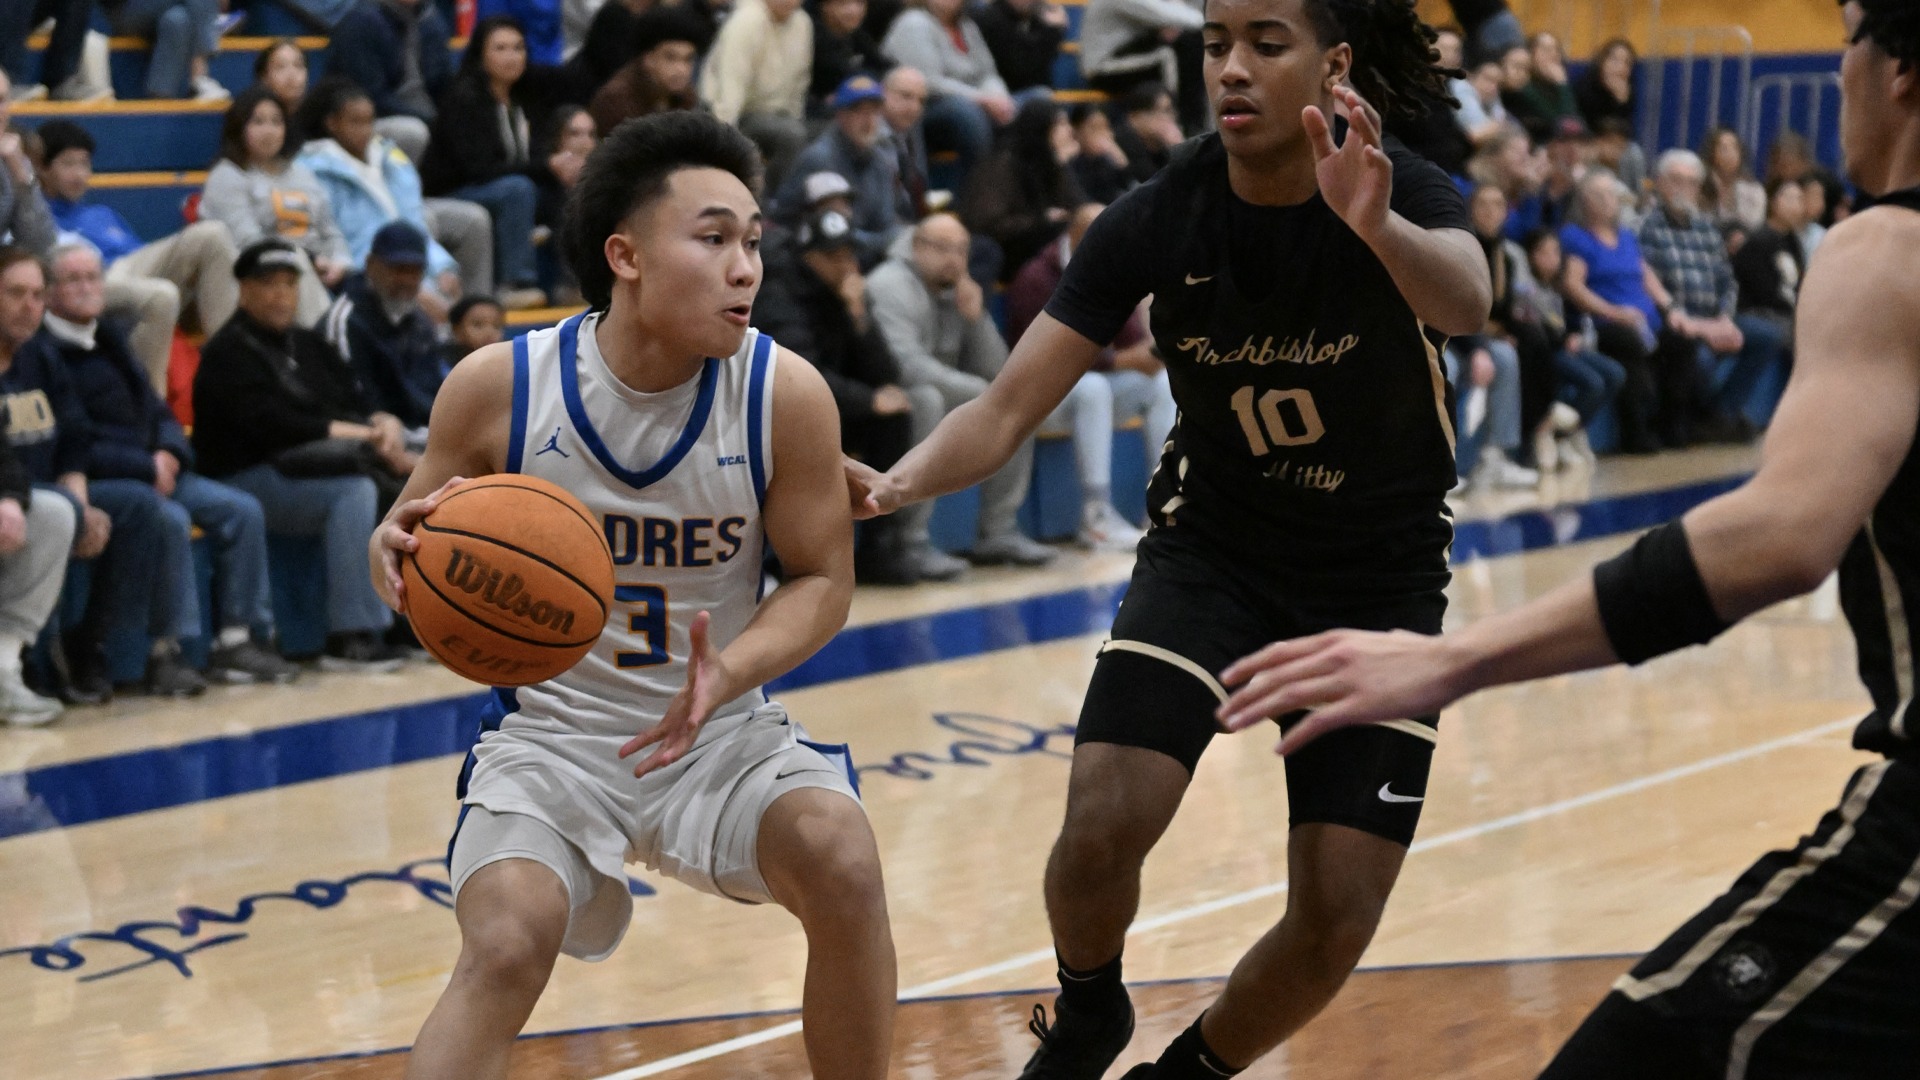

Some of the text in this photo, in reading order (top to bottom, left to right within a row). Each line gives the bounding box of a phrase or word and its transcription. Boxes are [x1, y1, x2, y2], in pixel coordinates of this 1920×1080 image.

[1177, 327, 1359, 366] Archbishop
[1230, 385, 1326, 457] 10
[717, 455, 747, 467] WCAL
[1262, 459, 1346, 493] Mitty
[603, 513, 747, 568] DRES
[445, 548, 575, 636] Wilson
[613, 581, 672, 670] 3
